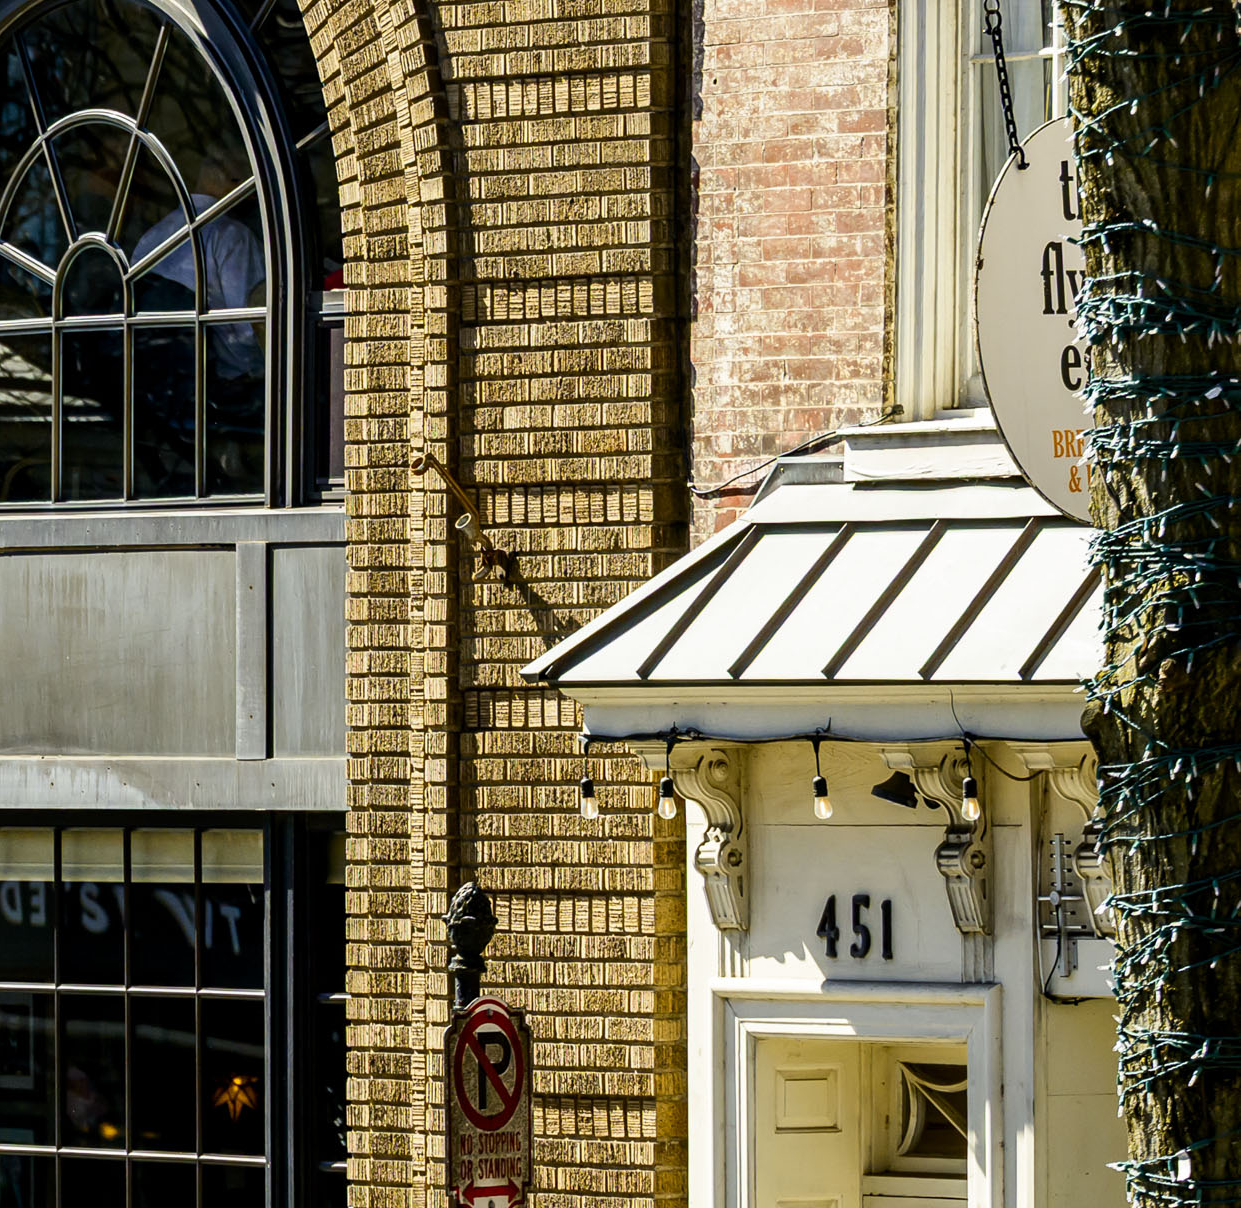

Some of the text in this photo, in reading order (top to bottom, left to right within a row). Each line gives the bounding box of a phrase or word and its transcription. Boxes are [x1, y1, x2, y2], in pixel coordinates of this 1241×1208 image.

[816, 894, 893, 960] 451
[459, 1130, 522, 1156] NO STOPPING
[459, 1156, 522, 1180] OR STANDING
